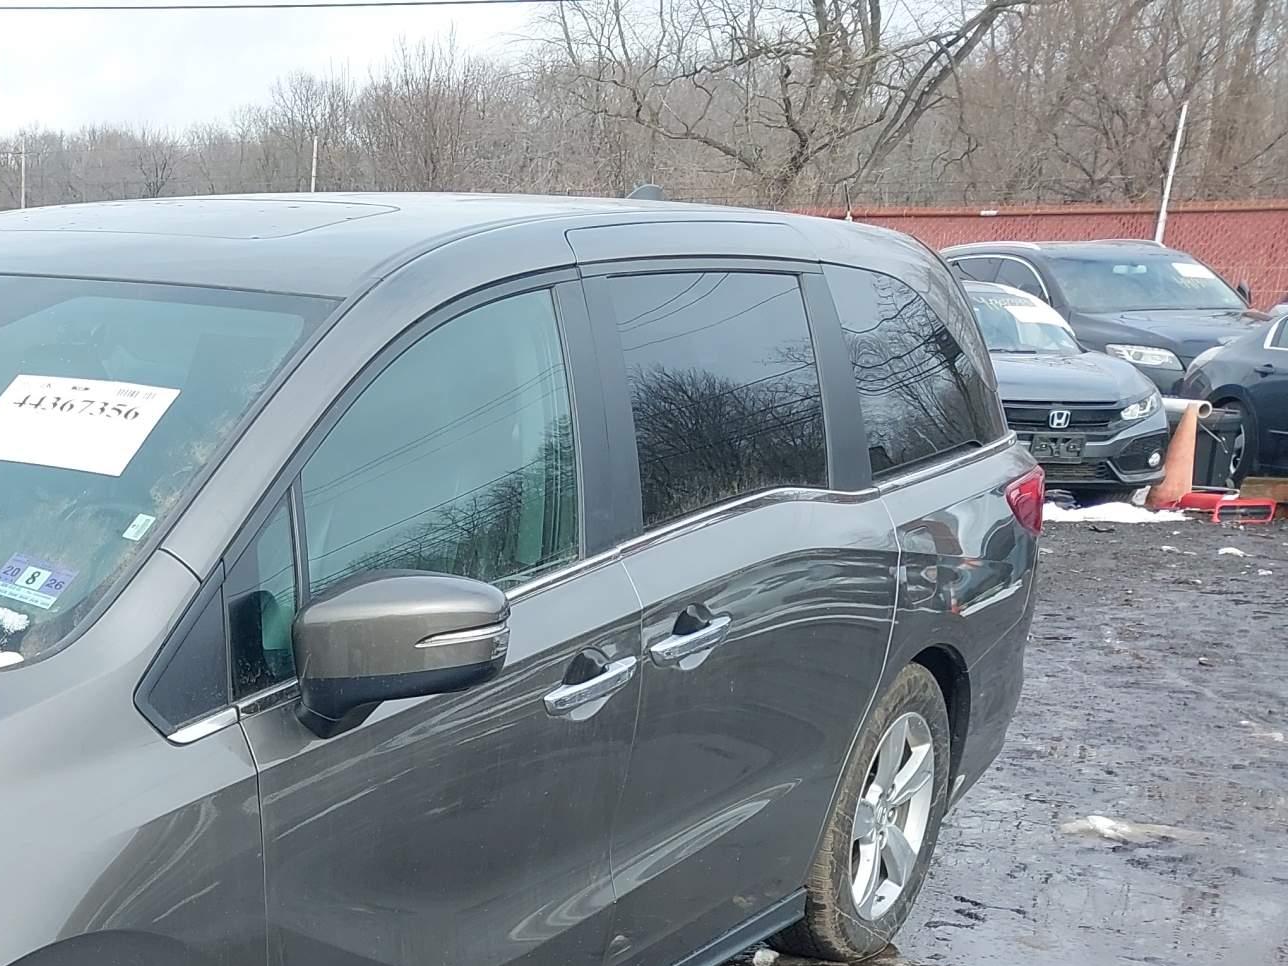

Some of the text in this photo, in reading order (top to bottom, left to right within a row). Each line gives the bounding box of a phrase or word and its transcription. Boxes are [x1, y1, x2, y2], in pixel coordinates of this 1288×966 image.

[14, 394, 140, 421] 44367356
[2, 565, 66, 591] 20 8 26
